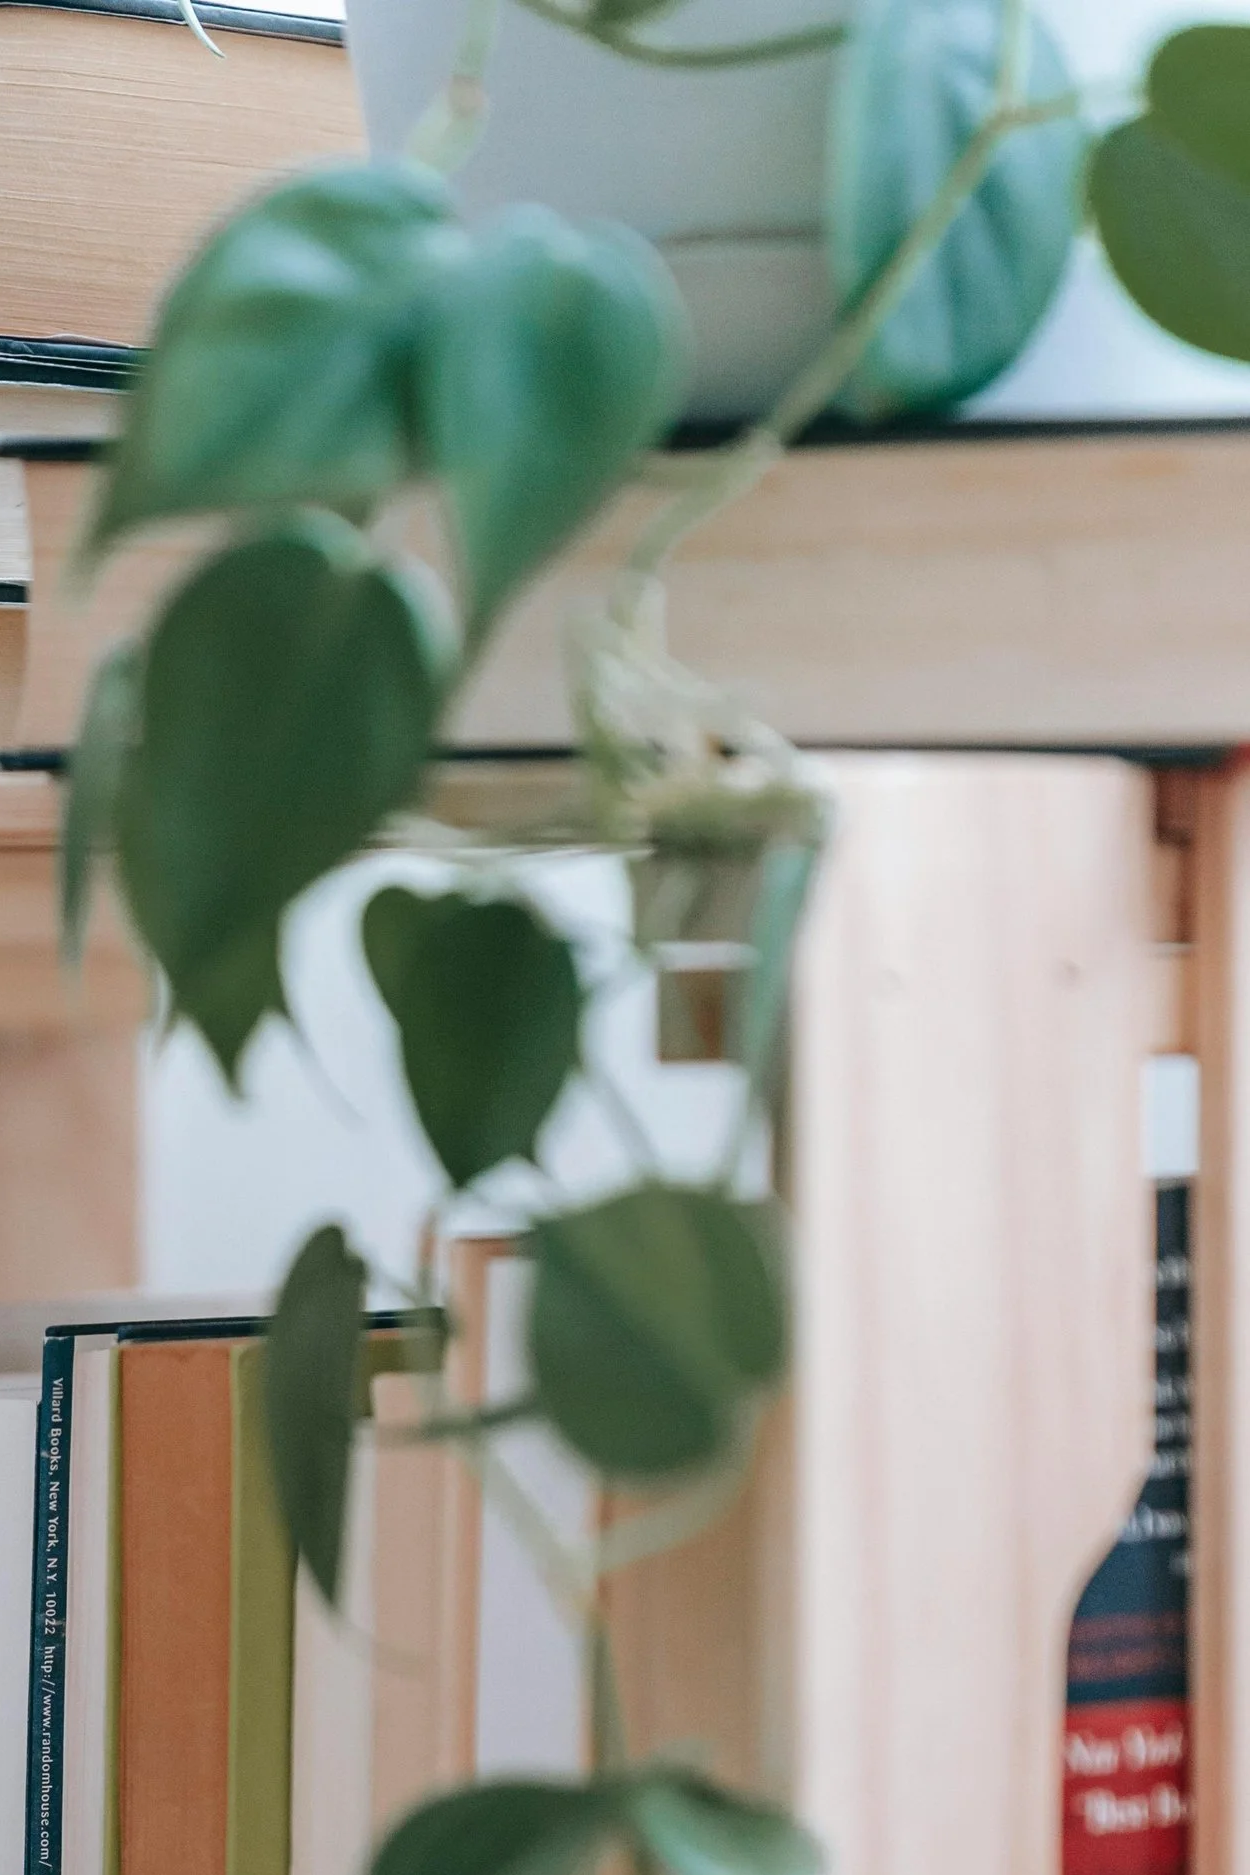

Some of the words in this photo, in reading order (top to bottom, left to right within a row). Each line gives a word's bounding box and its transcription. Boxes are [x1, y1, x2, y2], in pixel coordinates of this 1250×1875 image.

[51, 1377, 64, 1423] Villard
[48, 1427, 62, 1476] Books,
[48, 1481, 60, 1512] New
[46, 1515, 59, 1552] York,
[45, 1557, 58, 1585] N.Y.
[44, 1592, 56, 1635] 10022
[38, 1646, 55, 1868] http://www.randomhouse.com/
